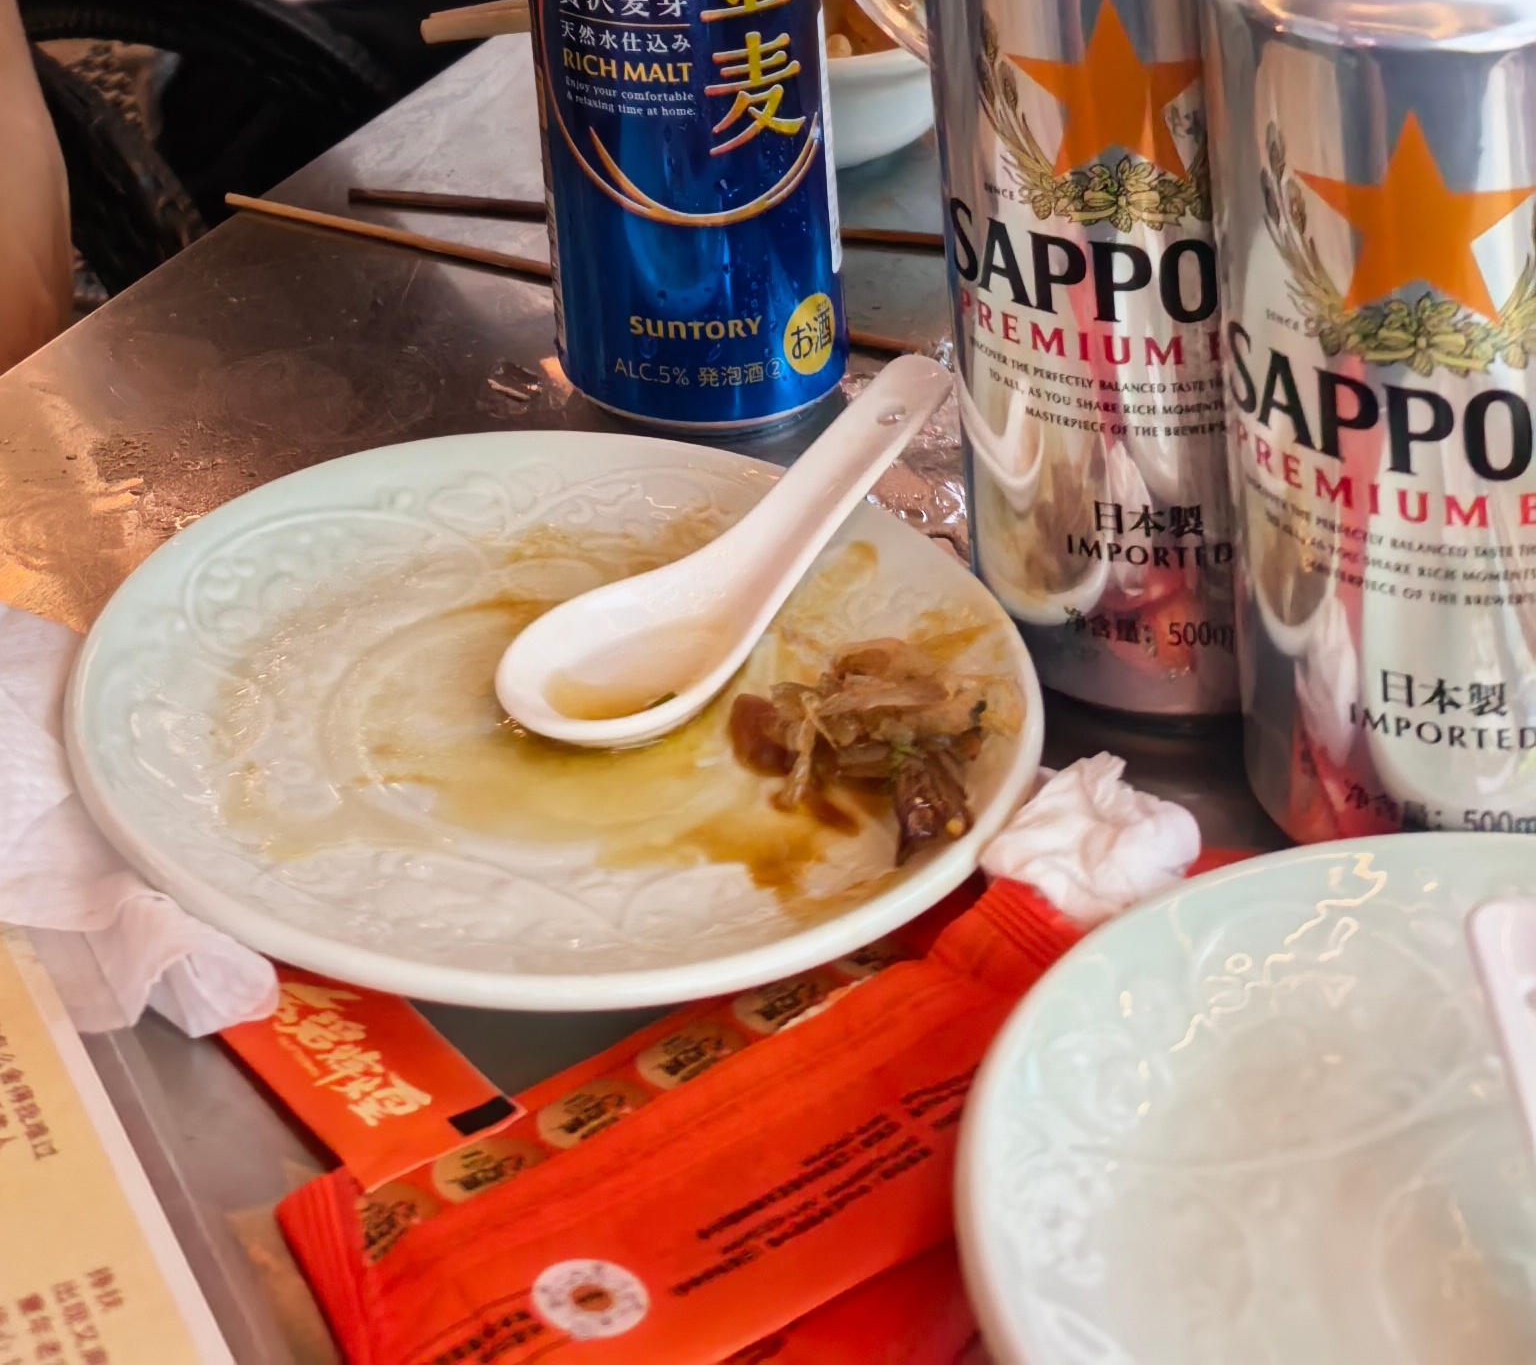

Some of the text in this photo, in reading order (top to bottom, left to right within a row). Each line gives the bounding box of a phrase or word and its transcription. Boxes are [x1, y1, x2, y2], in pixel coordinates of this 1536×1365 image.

[560, 19, 692, 53] 天然水仕込み
[563, 47, 693, 83] RICH MALT
[565, 75, 694, 102] Enjoy your comfortable
[576, 95, 615, 114] relaxing
[618, 103, 642, 115] time
[646, 106, 659, 116] at
[662, 106, 696, 117] home.
[791, 305, 833, 360] お酒
[960, 286, 1183, 367] PREMIUM
[615, 357, 690, 386] ALC.5%
[1033, 365, 1094, 390] PERFECTLY
[1099, 379, 1167, 394] BALANCED
[1171, 379, 1205, 393] TASTE
[1028, 386, 1042, 400] AS
[1045, 391, 1071, 406] YOU
[1076, 397, 1117, 413] SHARE
[1123, 402, 1157, 415] RICH
[1227, 320, 1534, 482] SAPPO
[1025, 405, 1106, 434] MASTERPIECE
[1110, 423, 1129, 436] OF
[1134, 425, 1158, 438] THE
[1235, 415, 1491, 530] PREMIUM
[1093, 499, 1205, 539] 日本製
[1066, 534, 1233, 569] IMPORTED
[1381, 668, 1508, 717] 日本製
[1350, 701, 1536, 751] IMPORTED
